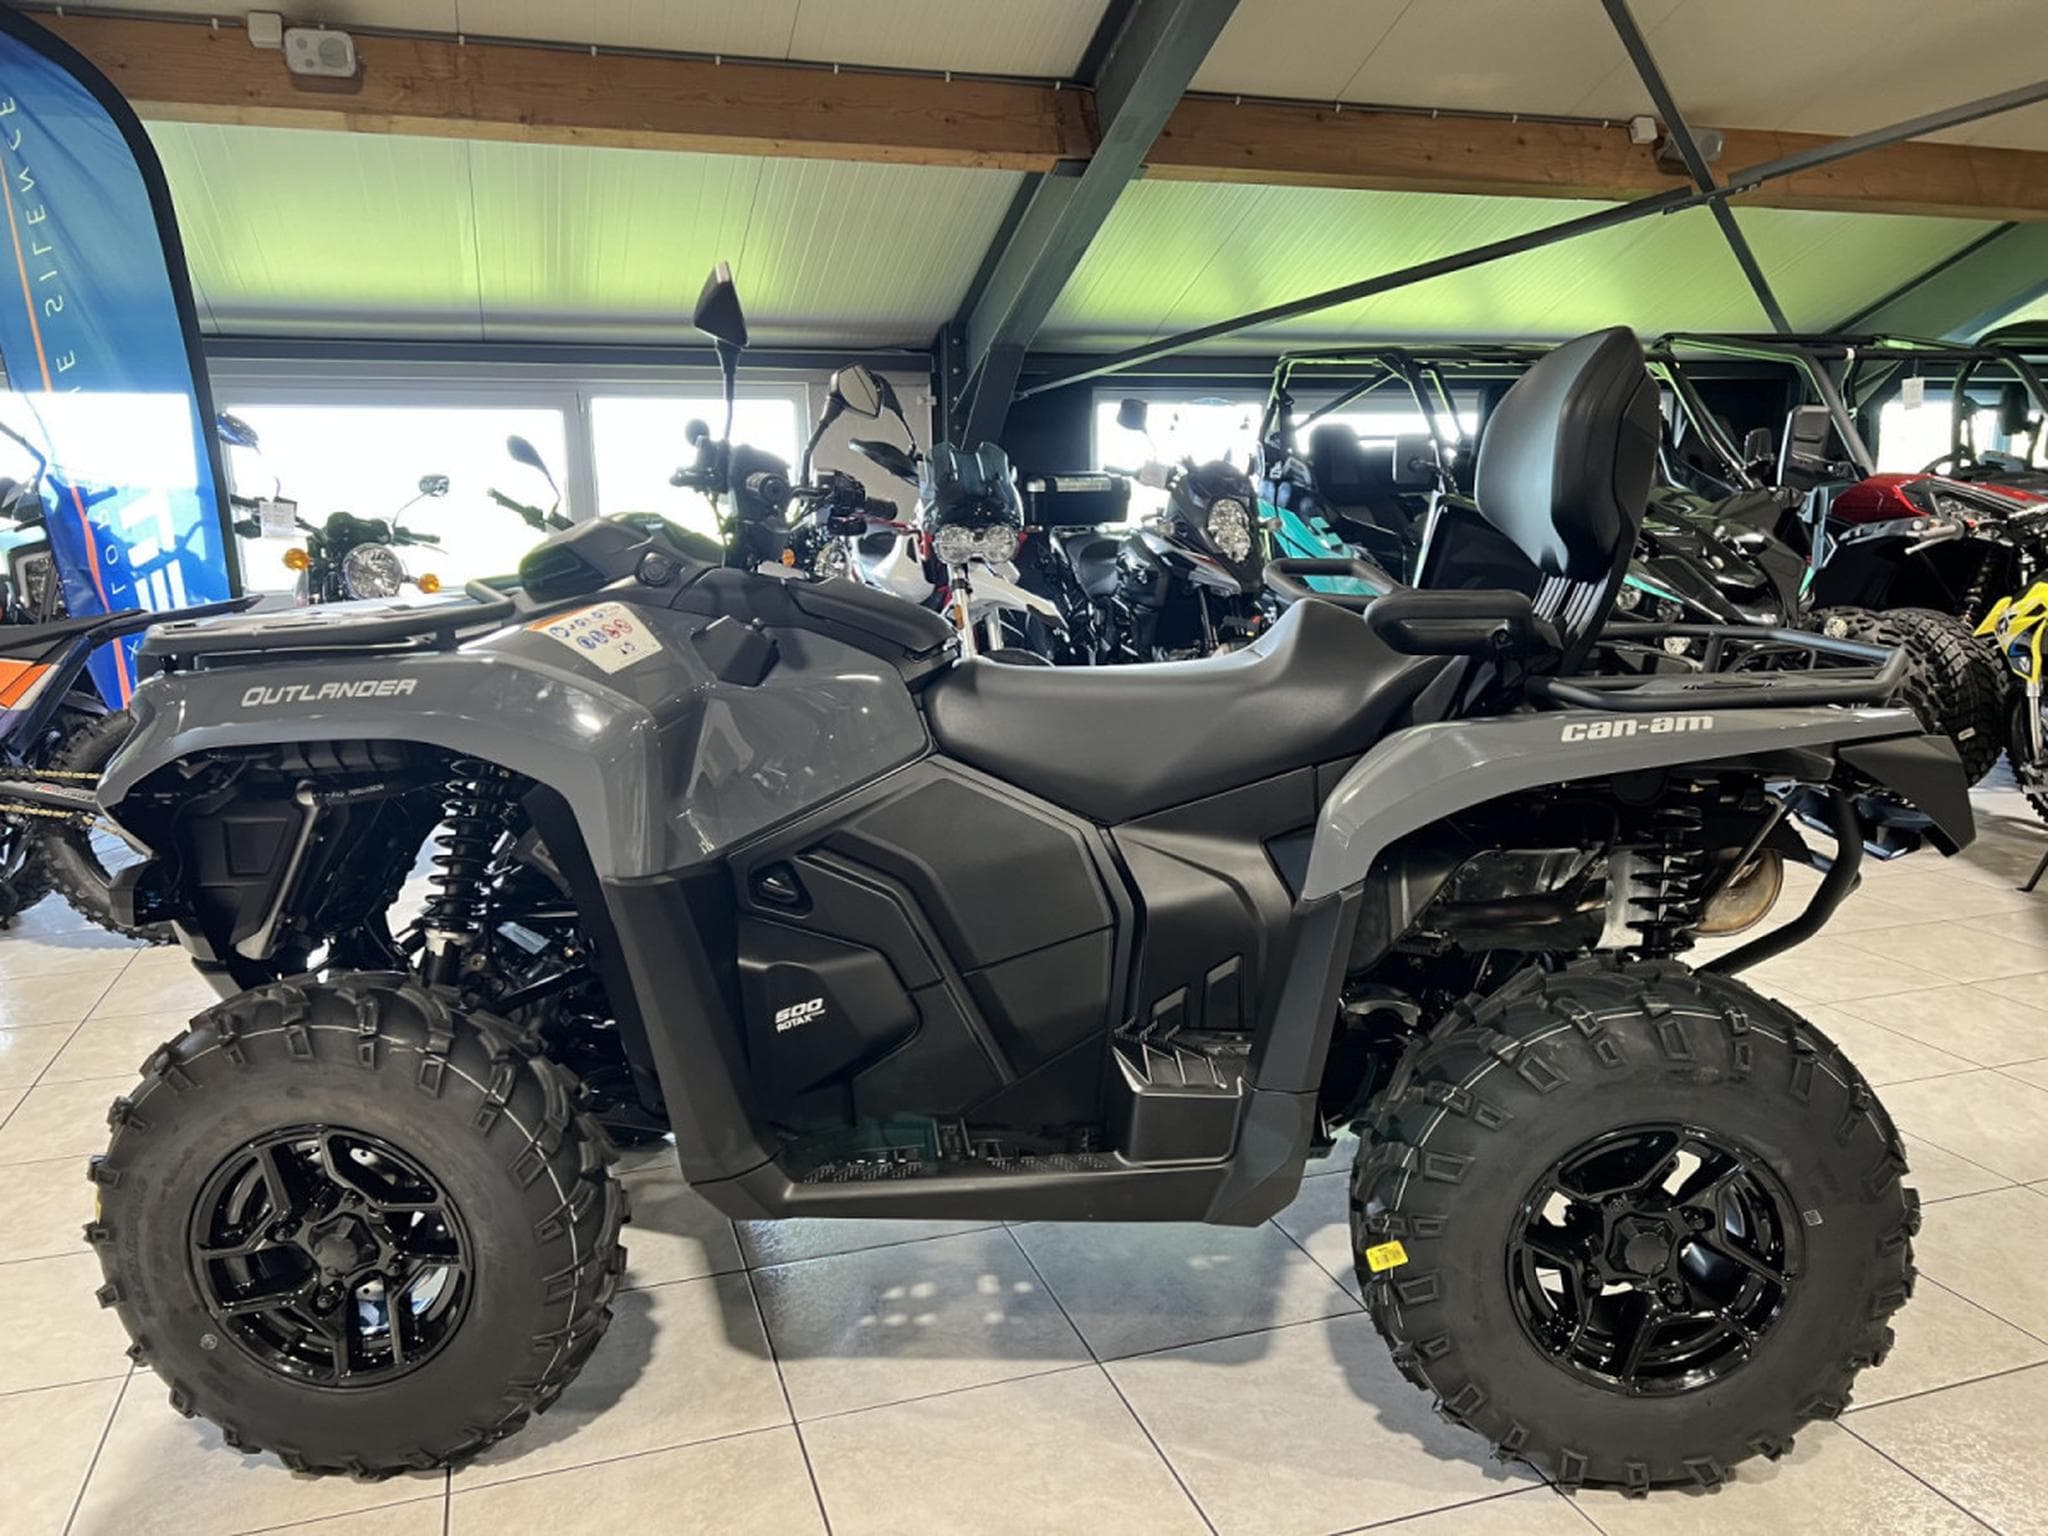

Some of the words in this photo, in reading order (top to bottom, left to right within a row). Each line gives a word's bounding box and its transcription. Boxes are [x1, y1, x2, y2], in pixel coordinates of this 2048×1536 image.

[241, 678, 418, 707] OUTLANDER
[1561, 715, 1714, 743] can-am
[775, 997, 823, 1024] 500
